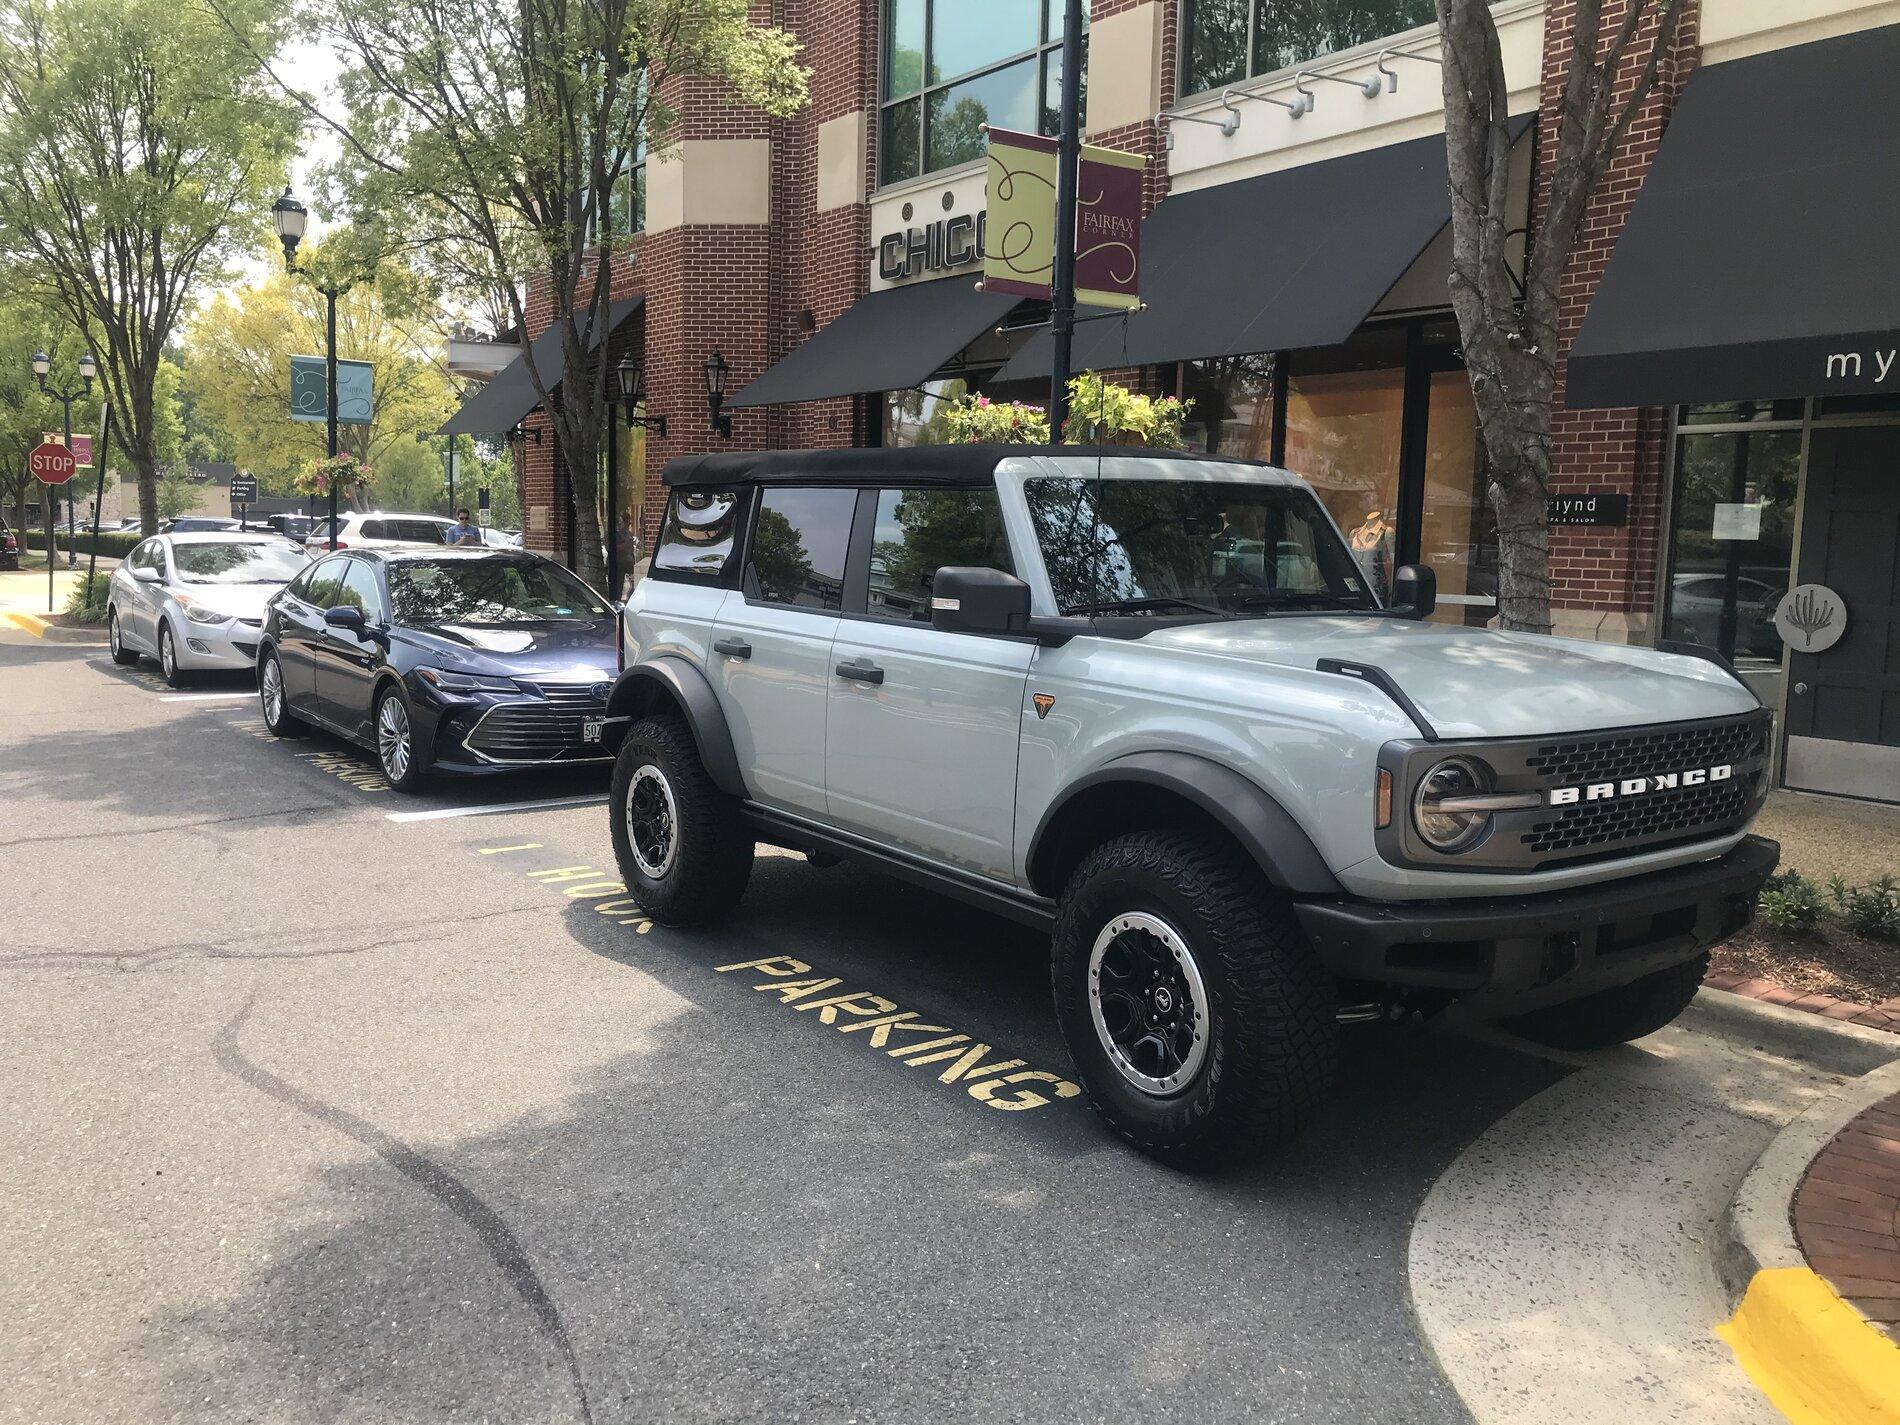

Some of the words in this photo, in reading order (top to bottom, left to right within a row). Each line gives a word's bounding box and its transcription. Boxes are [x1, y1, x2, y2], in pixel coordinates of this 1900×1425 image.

[1084, 212, 1134, 232] FAIRFAX
[1083, 225, 1134, 240] CORNER
[1826, 349, 1897, 383] my
[33, 454, 73, 472] STOP
[1551, 764, 1732, 805] BRONCO
[477, 843, 543, 855] 1
[714, 955, 1081, 1111] PARKING
